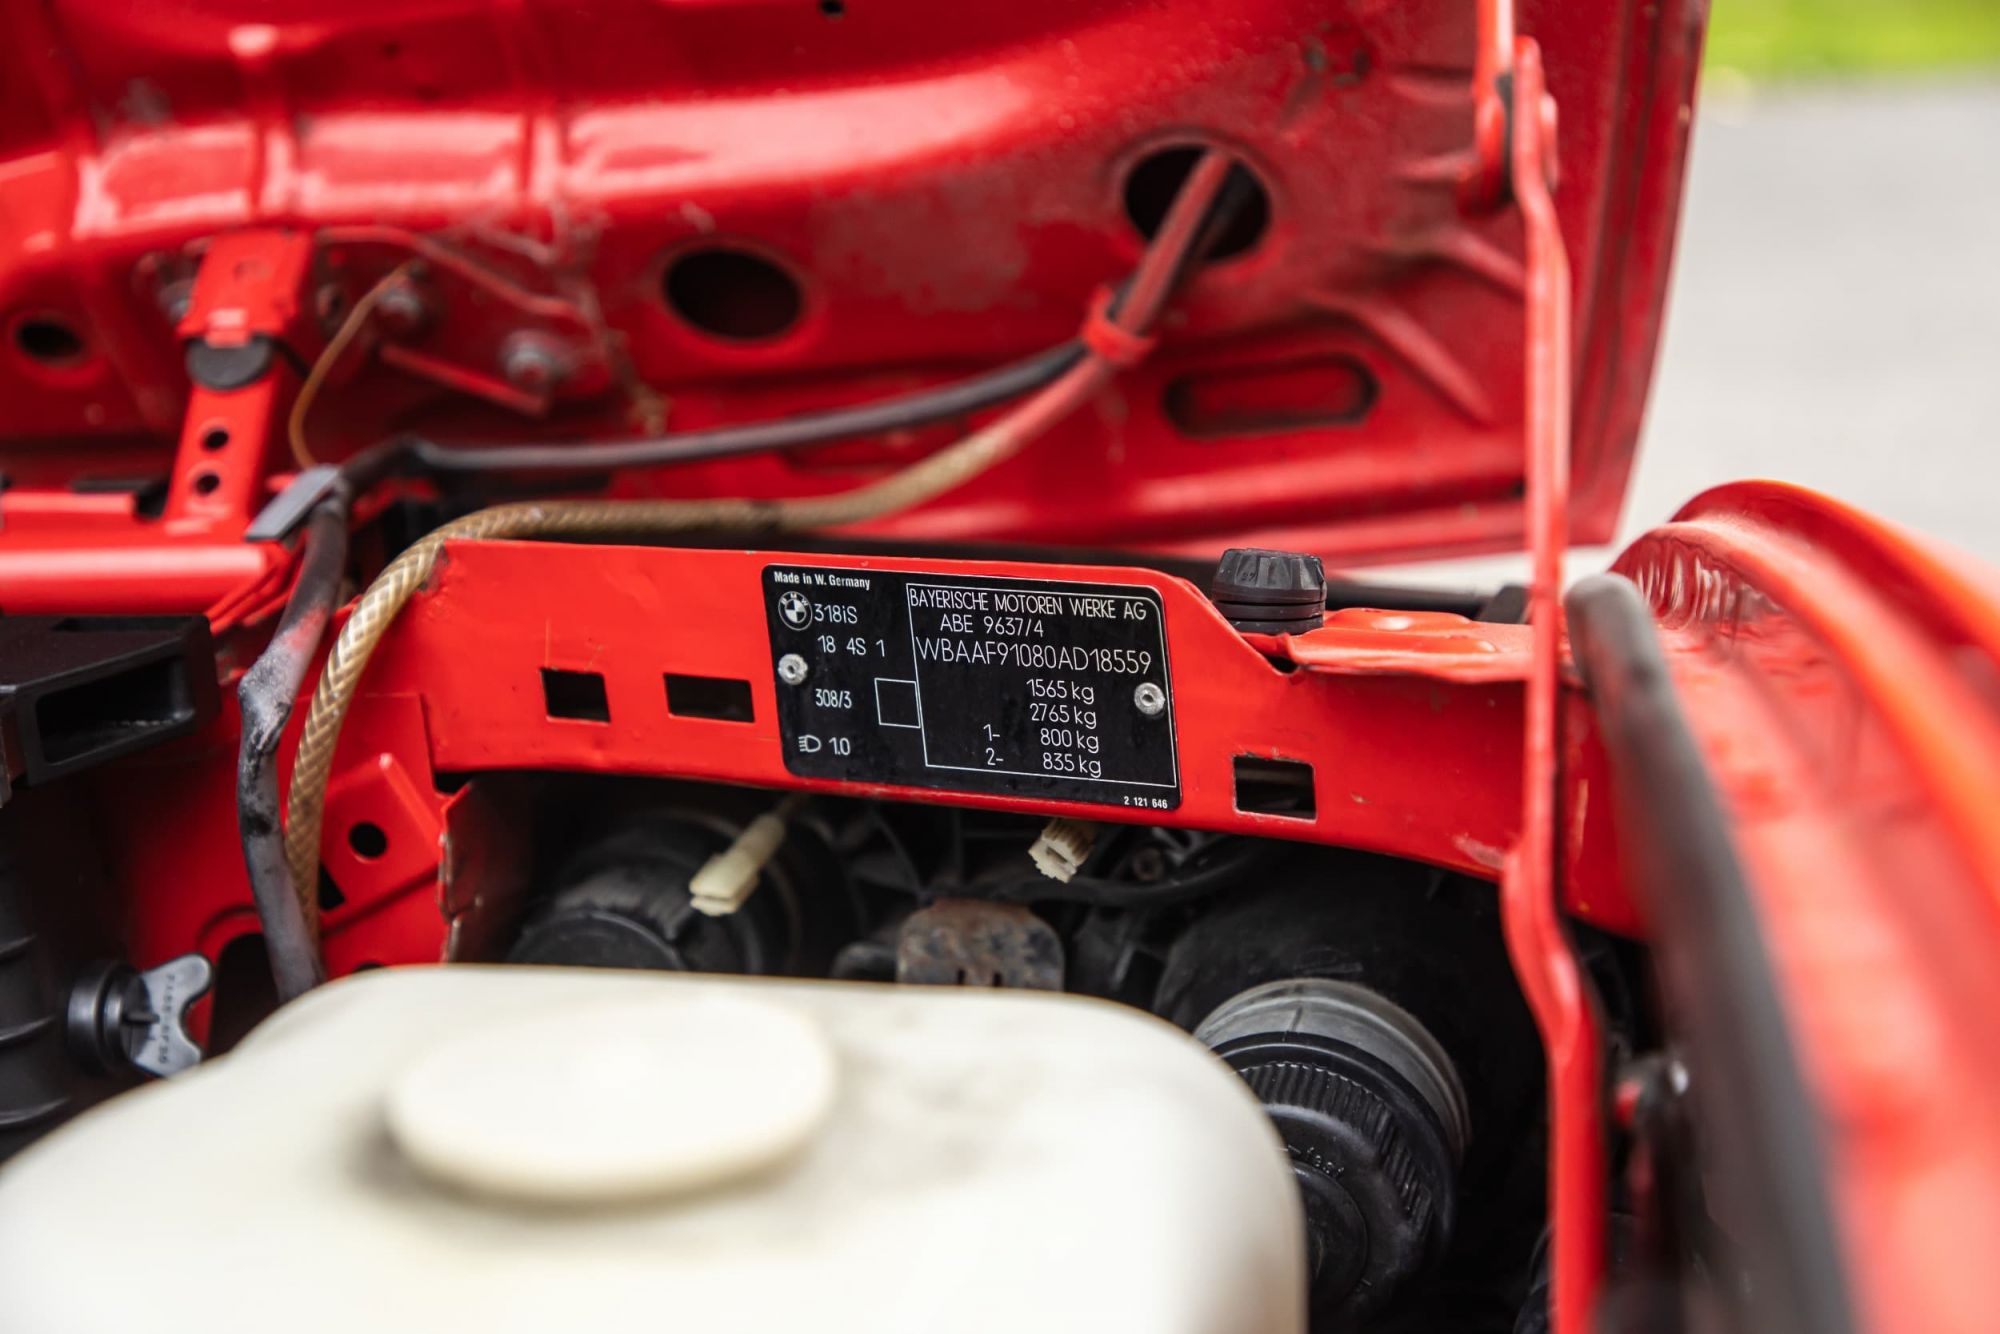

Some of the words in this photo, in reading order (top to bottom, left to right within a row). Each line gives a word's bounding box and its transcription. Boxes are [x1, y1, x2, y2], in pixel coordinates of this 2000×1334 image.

[773, 571, 800, 584] Made
[802, 573, 812, 585] in
[814, 573, 827, 586] W.
[828, 575, 871, 591] Germany
[813, 603, 858, 624] 318iS
[909, 587, 989, 612] BAYERISCHE
[994, 593, 1063, 615] MOTOREN
[1068, 597, 1116, 619] WERKE
[1123, 601, 1147, 621] AG
[939, 613, 974, 633] ABE
[983, 615, 1044, 638] 9637/4
[817, 635, 836, 654] 18
[846, 637, 867, 656] 4S
[875, 639, 885, 658] 1
[915, 636, 1153, 675] WBAAF91080AD18559
[814, 688, 853, 709] 308/3
[1025, 678, 1068, 699] 1565
[1070, 680, 1095, 705] kg
[1029, 703, 1071, 723] 2765
[1073, 705, 1098, 730] kg
[982, 723, 1001, 742] 1-
[1040, 728, 1073, 748] 800
[1075, 730, 1100, 754] kg
[985, 747, 1005, 766] 2-
[1042, 752, 1075, 773] 835
[1078, 754, 1102, 778] kg
[1123, 795, 1130, 806] 2
[1134, 797, 1148, 807] 121
[1152, 798, 1168, 809] 646
